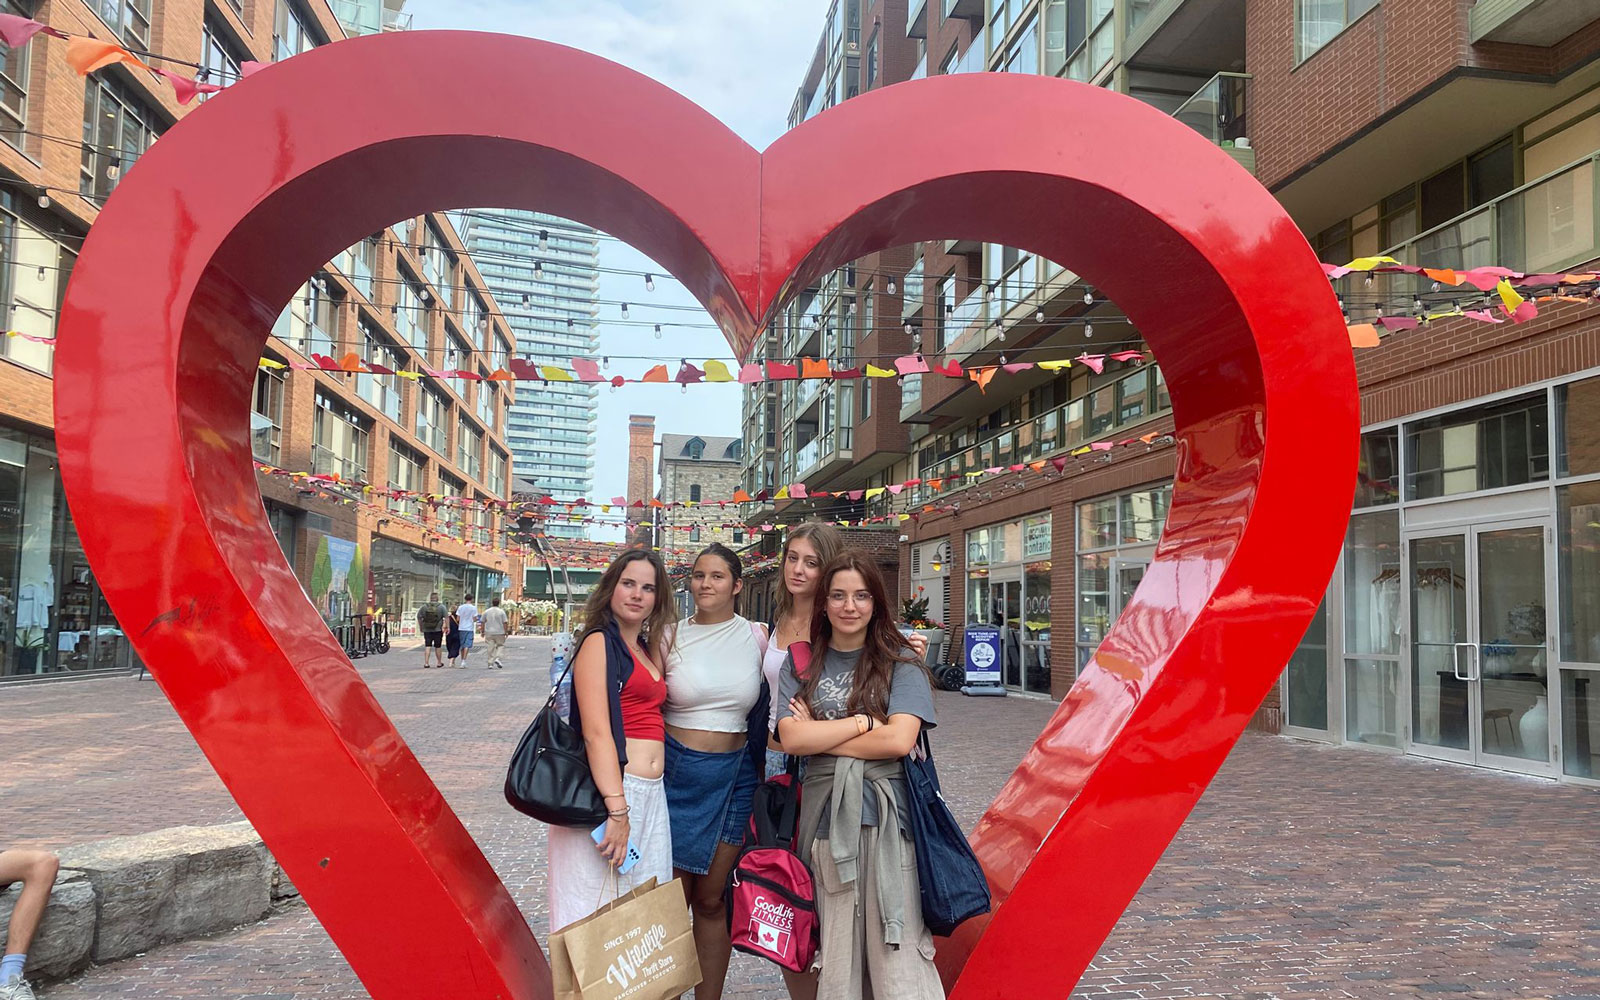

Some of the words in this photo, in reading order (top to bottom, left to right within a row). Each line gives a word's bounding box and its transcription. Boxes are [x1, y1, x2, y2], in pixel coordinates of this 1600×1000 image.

[754, 896, 794, 919] GoodLife
[603, 935, 625, 952] SINCE
[625, 926, 642, 940] 1997
[606, 924, 667, 990] Wildlife
[642, 962, 659, 978] Thrift
[657, 955, 674, 969] Store
[613, 980, 648, 1000] VANCOUVER
[652, 964, 677, 981] TORONTO
